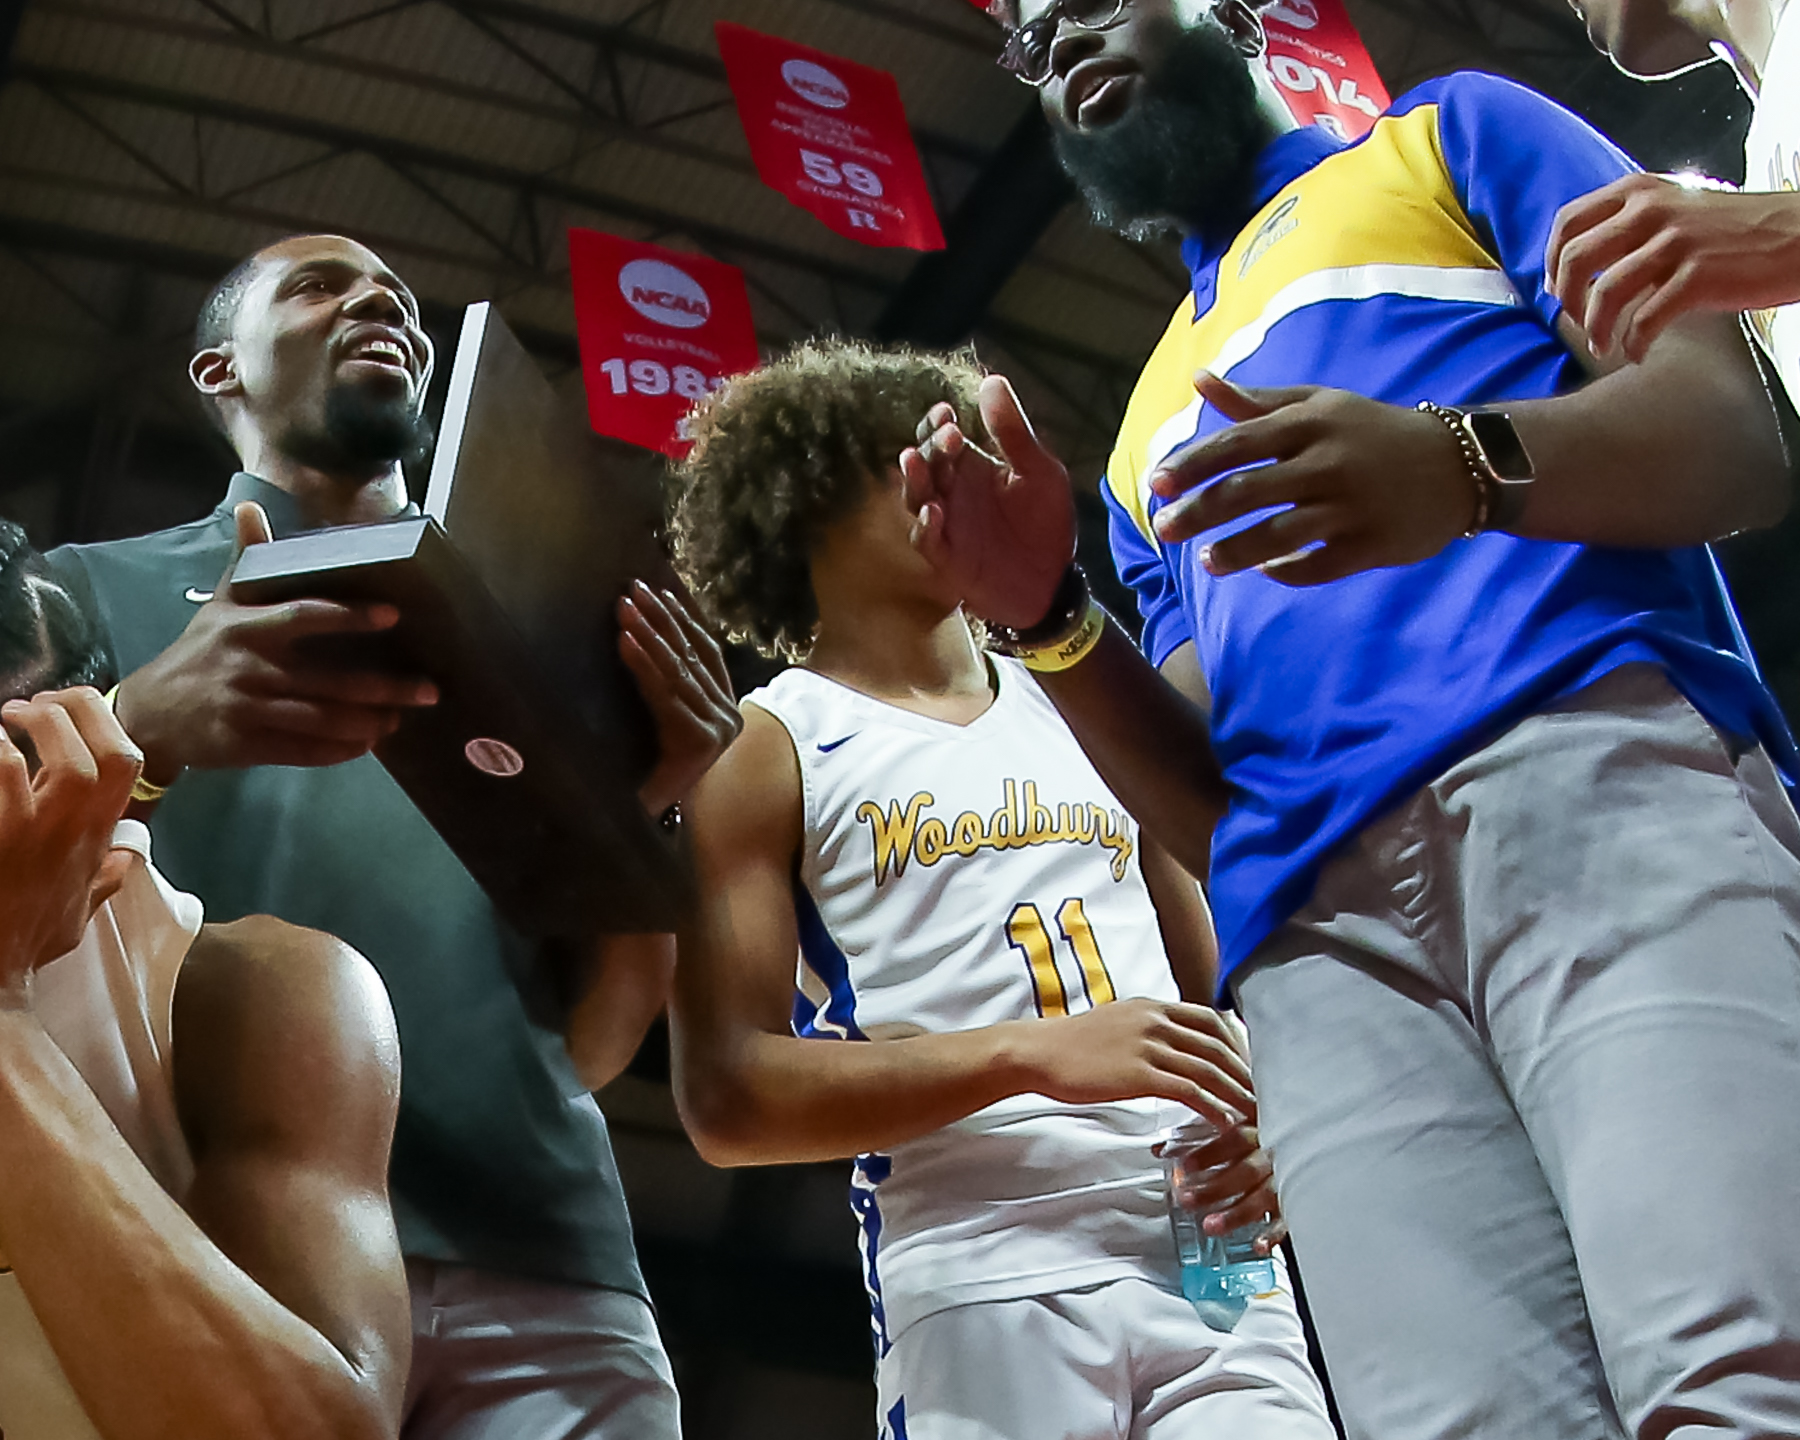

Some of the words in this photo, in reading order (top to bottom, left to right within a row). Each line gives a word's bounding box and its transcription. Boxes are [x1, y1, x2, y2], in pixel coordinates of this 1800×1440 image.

[1262, 55, 1382, 120] 014
[799, 148, 884, 197] 59
[631, 286, 710, 318] NCAA
[856, 778, 1134, 888] Woodbury
[1004, 897, 1116, 1018] 11
